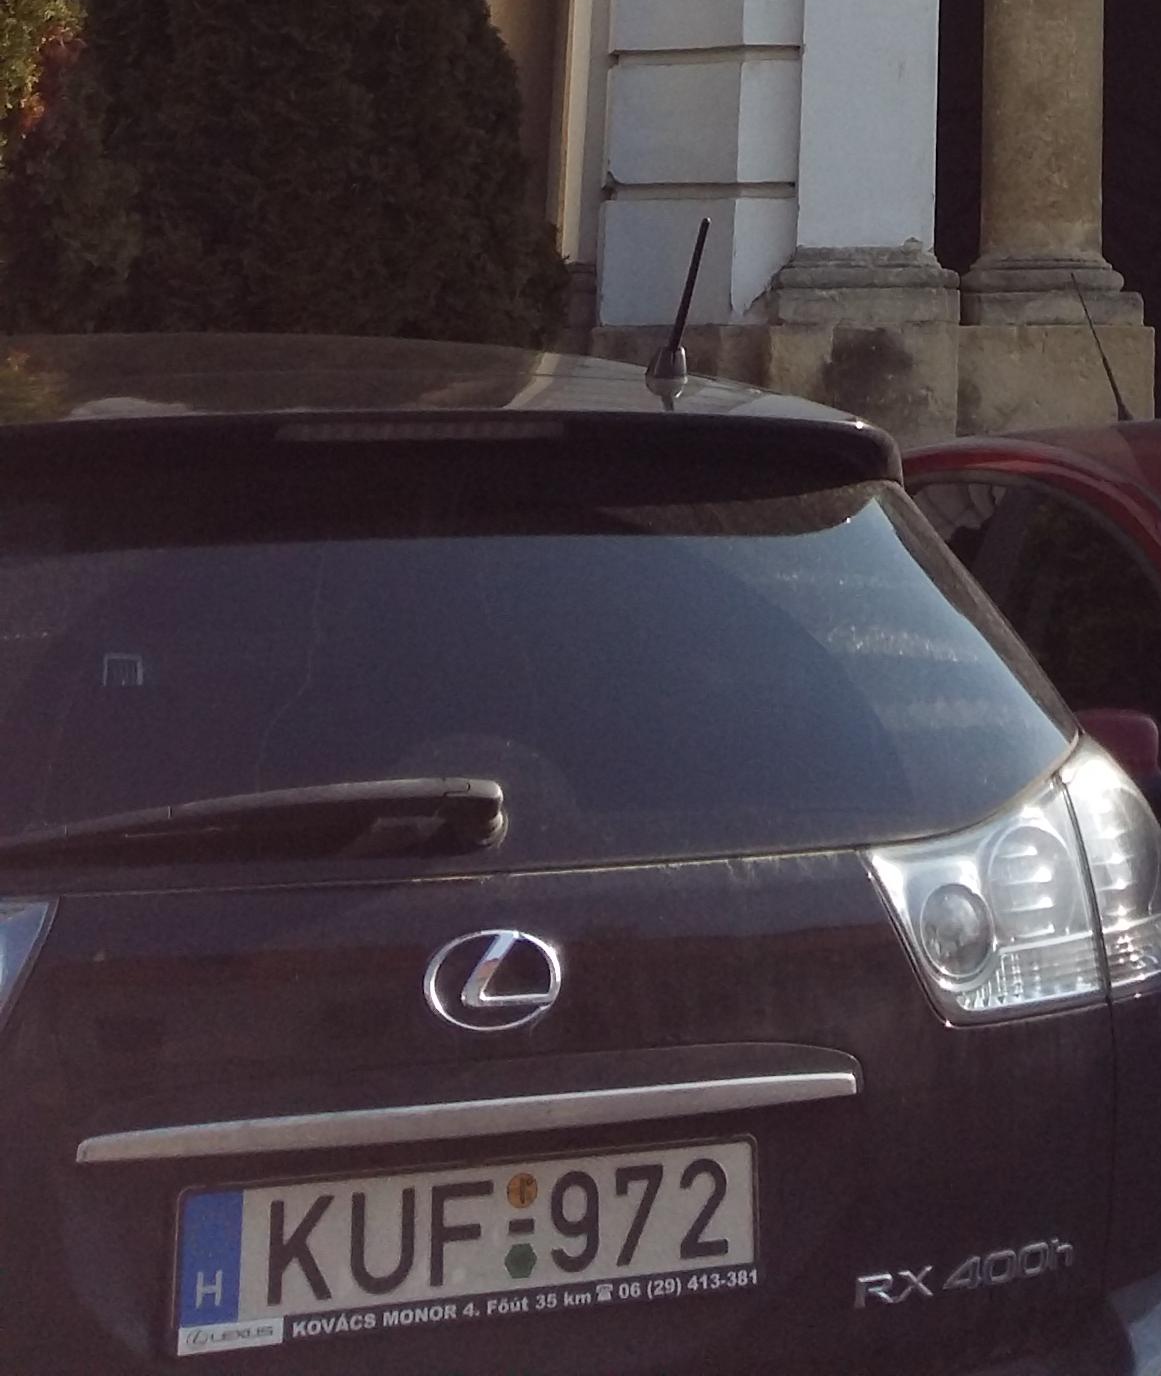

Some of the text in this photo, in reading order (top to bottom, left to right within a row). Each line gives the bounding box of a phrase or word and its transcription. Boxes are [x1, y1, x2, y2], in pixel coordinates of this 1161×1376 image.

[195, 1269, 223, 1309] H
[292, 1311, 376, 1338] KOVÁCS
[382, 1304, 457, 1328] MONOR
[462, 1302, 480, 1317] 4.
[535, 1294, 557, 1310] 35
[564, 1290, 592, 1306] km
[618, 1282, 641, 1299] 06
[647, 1278, 682, 1300] (29)
[687, 1268, 759, 1291] 413-381
[854, 1237, 1074, 1309] RX 400h
